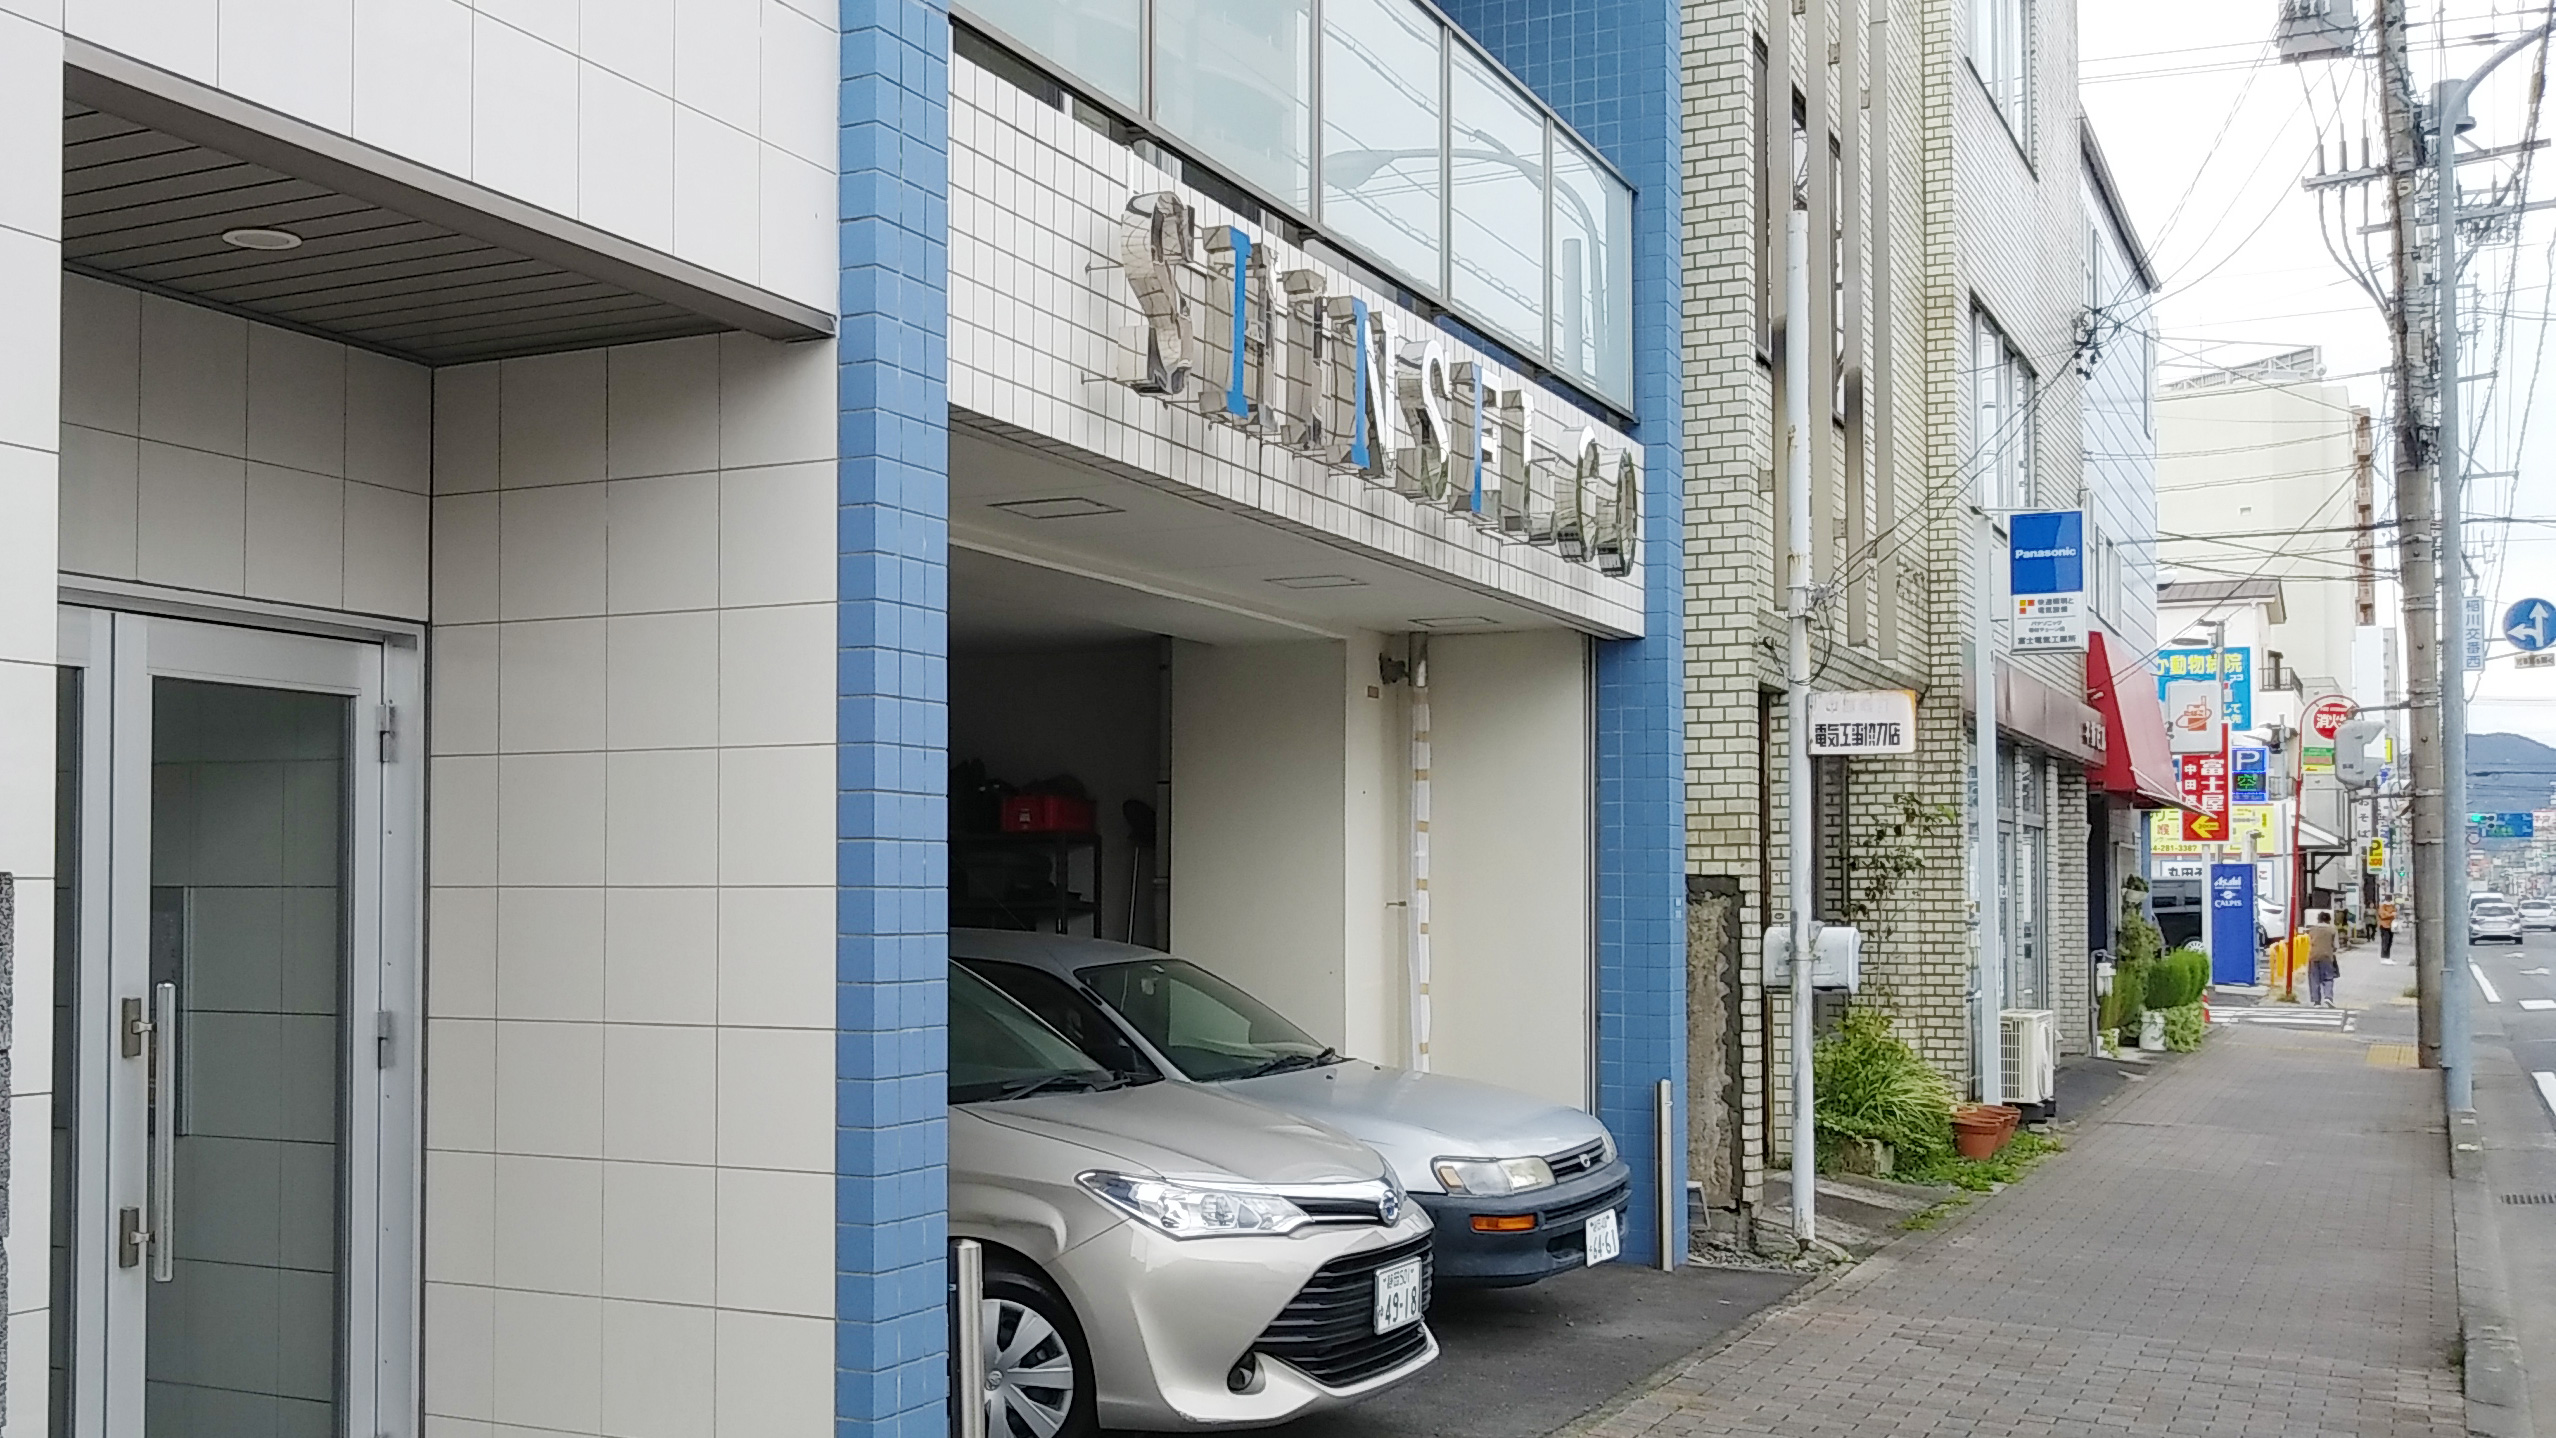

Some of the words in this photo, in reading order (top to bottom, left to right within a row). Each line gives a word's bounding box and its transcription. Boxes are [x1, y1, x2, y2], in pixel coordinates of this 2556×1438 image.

[2015, 546, 2077, 559] Panasonic
[2465, 599, 2481, 668] 稲川交番西
[1815, 722, 1901, 748] 電気工事協力店
[2236, 750, 2261, 770] P
[2200, 758, 2225, 812] 富士屋
[2368, 840, 2382, 857] P
[2214, 876, 2242, 887] Asahi
[2214, 899, 2243, 908] CALPIS
[1385, 1285, 1417, 1325] 49-18
